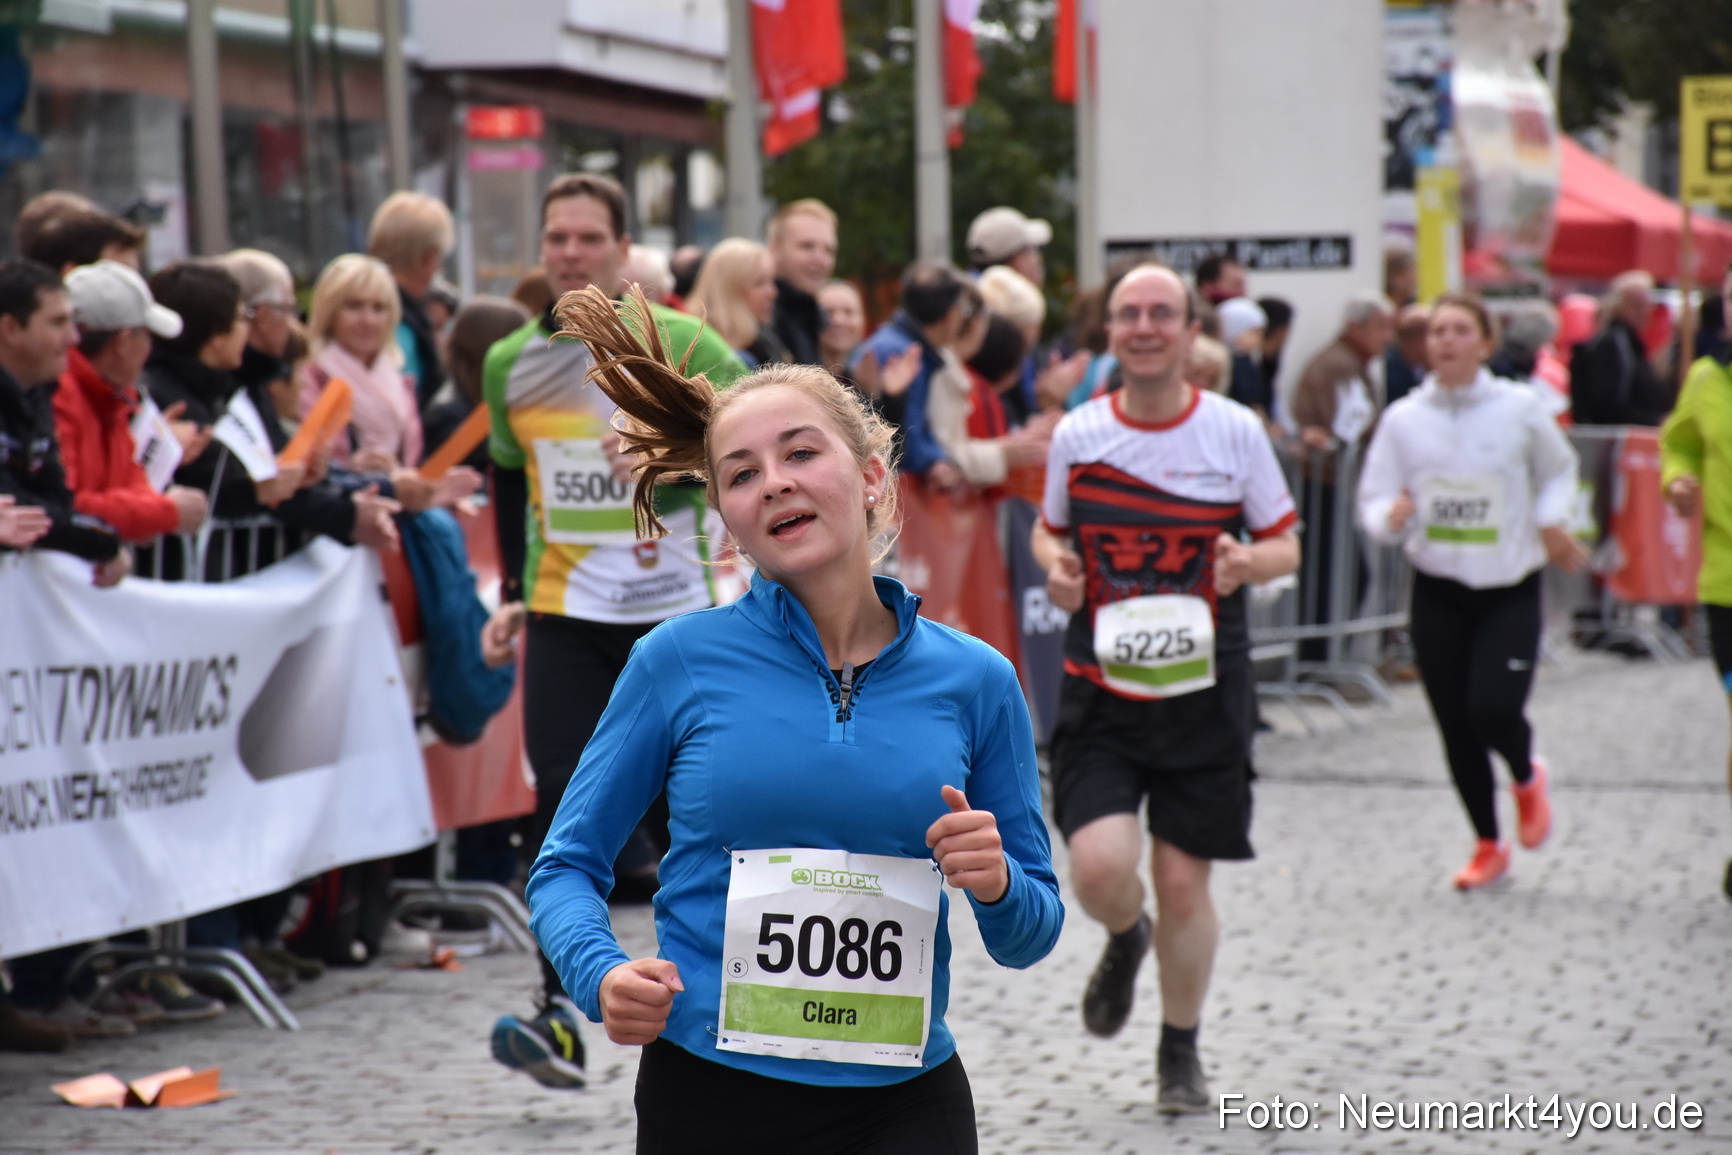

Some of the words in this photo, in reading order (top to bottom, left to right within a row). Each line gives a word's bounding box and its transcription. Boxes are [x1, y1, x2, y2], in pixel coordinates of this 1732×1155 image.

[554, 471, 627, 503] 5500
[1116, 627, 1194, 664] 5225
[814, 869, 882, 891] BOCK
[757, 912, 903, 982] 5086
[733, 962, 741, 973] S
[803, 1001, 857, 1025] Clara
